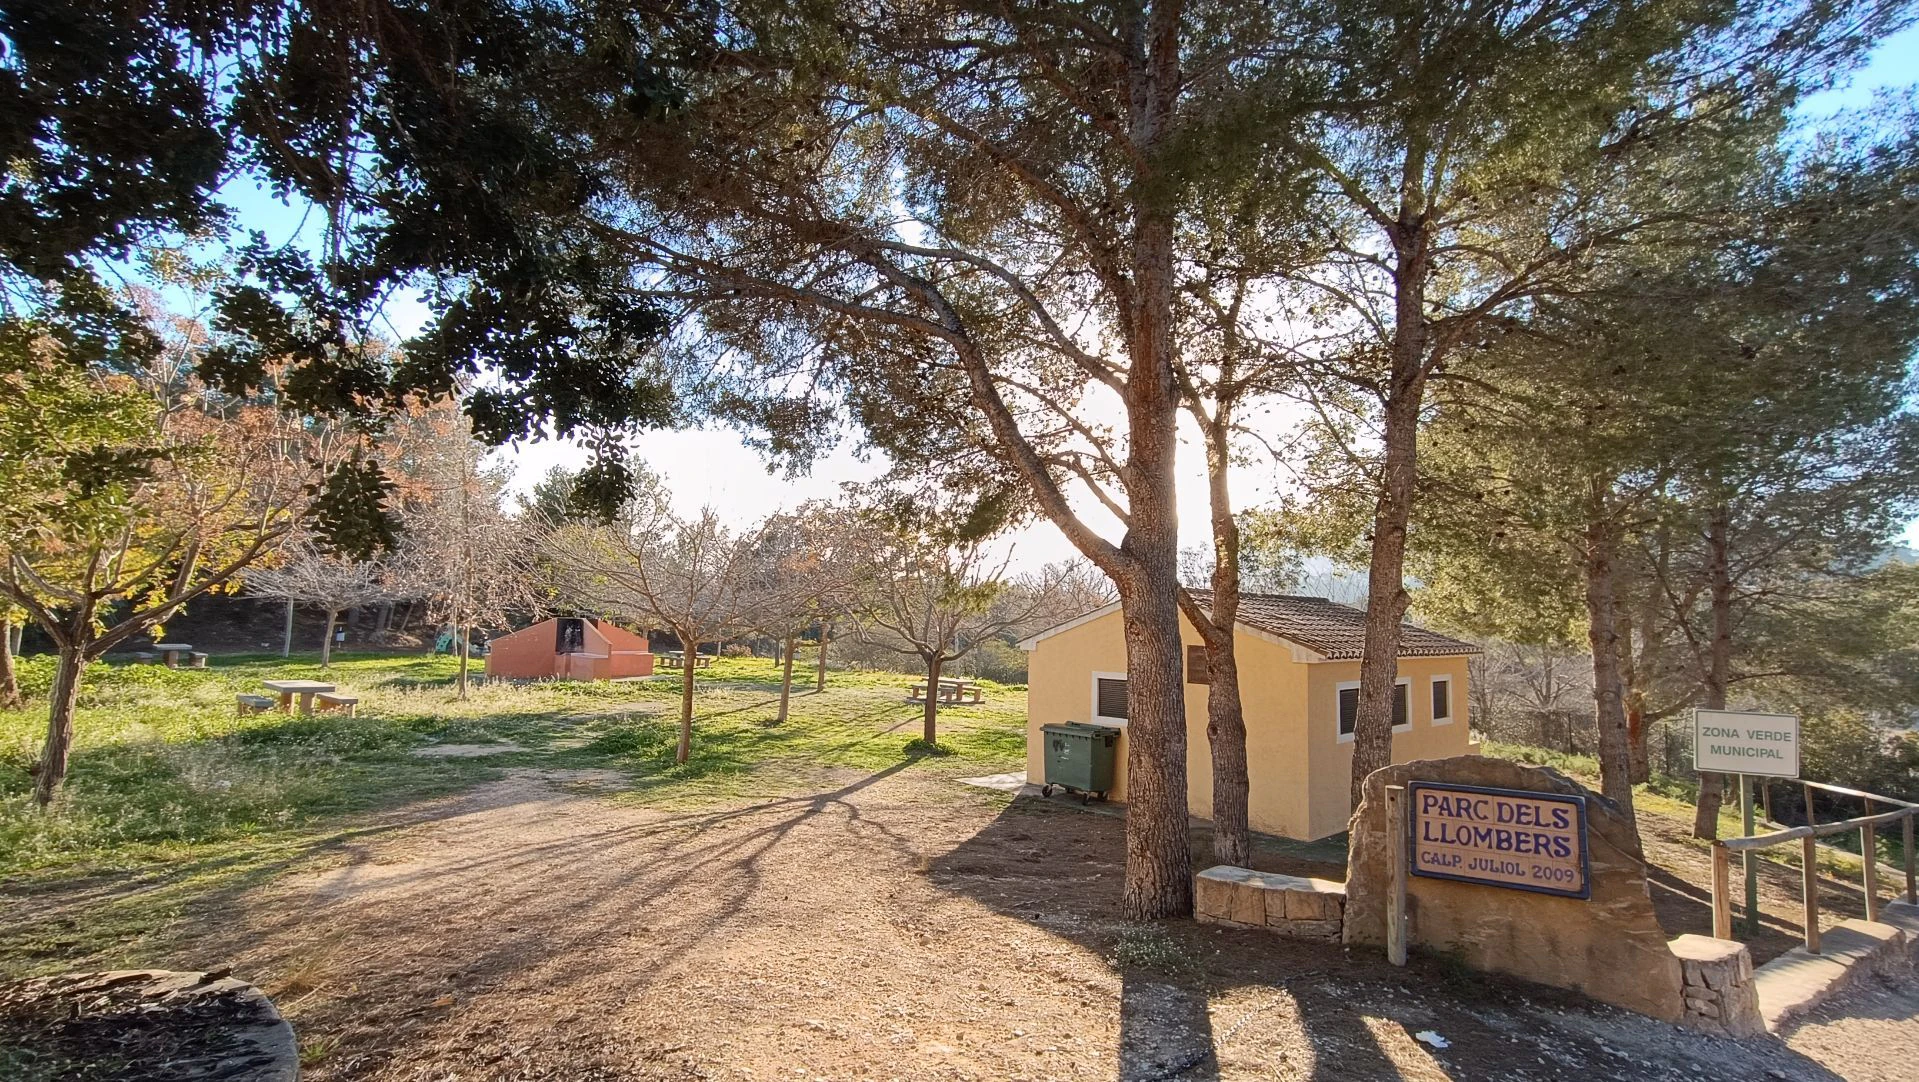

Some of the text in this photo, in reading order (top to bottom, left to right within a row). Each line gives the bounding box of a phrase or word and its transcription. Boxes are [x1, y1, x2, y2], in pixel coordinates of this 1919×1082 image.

[1702, 726, 1792, 742] ZONA VERDE
[1710, 744, 1784, 759] MUNICIPAL
[1422, 794, 1569, 830] PARC DELS
[1423, 821, 1572, 859] LLOMBERS
[1468, 857, 1526, 876] JULIOL
[1531, 865, 1575, 883] 2009
